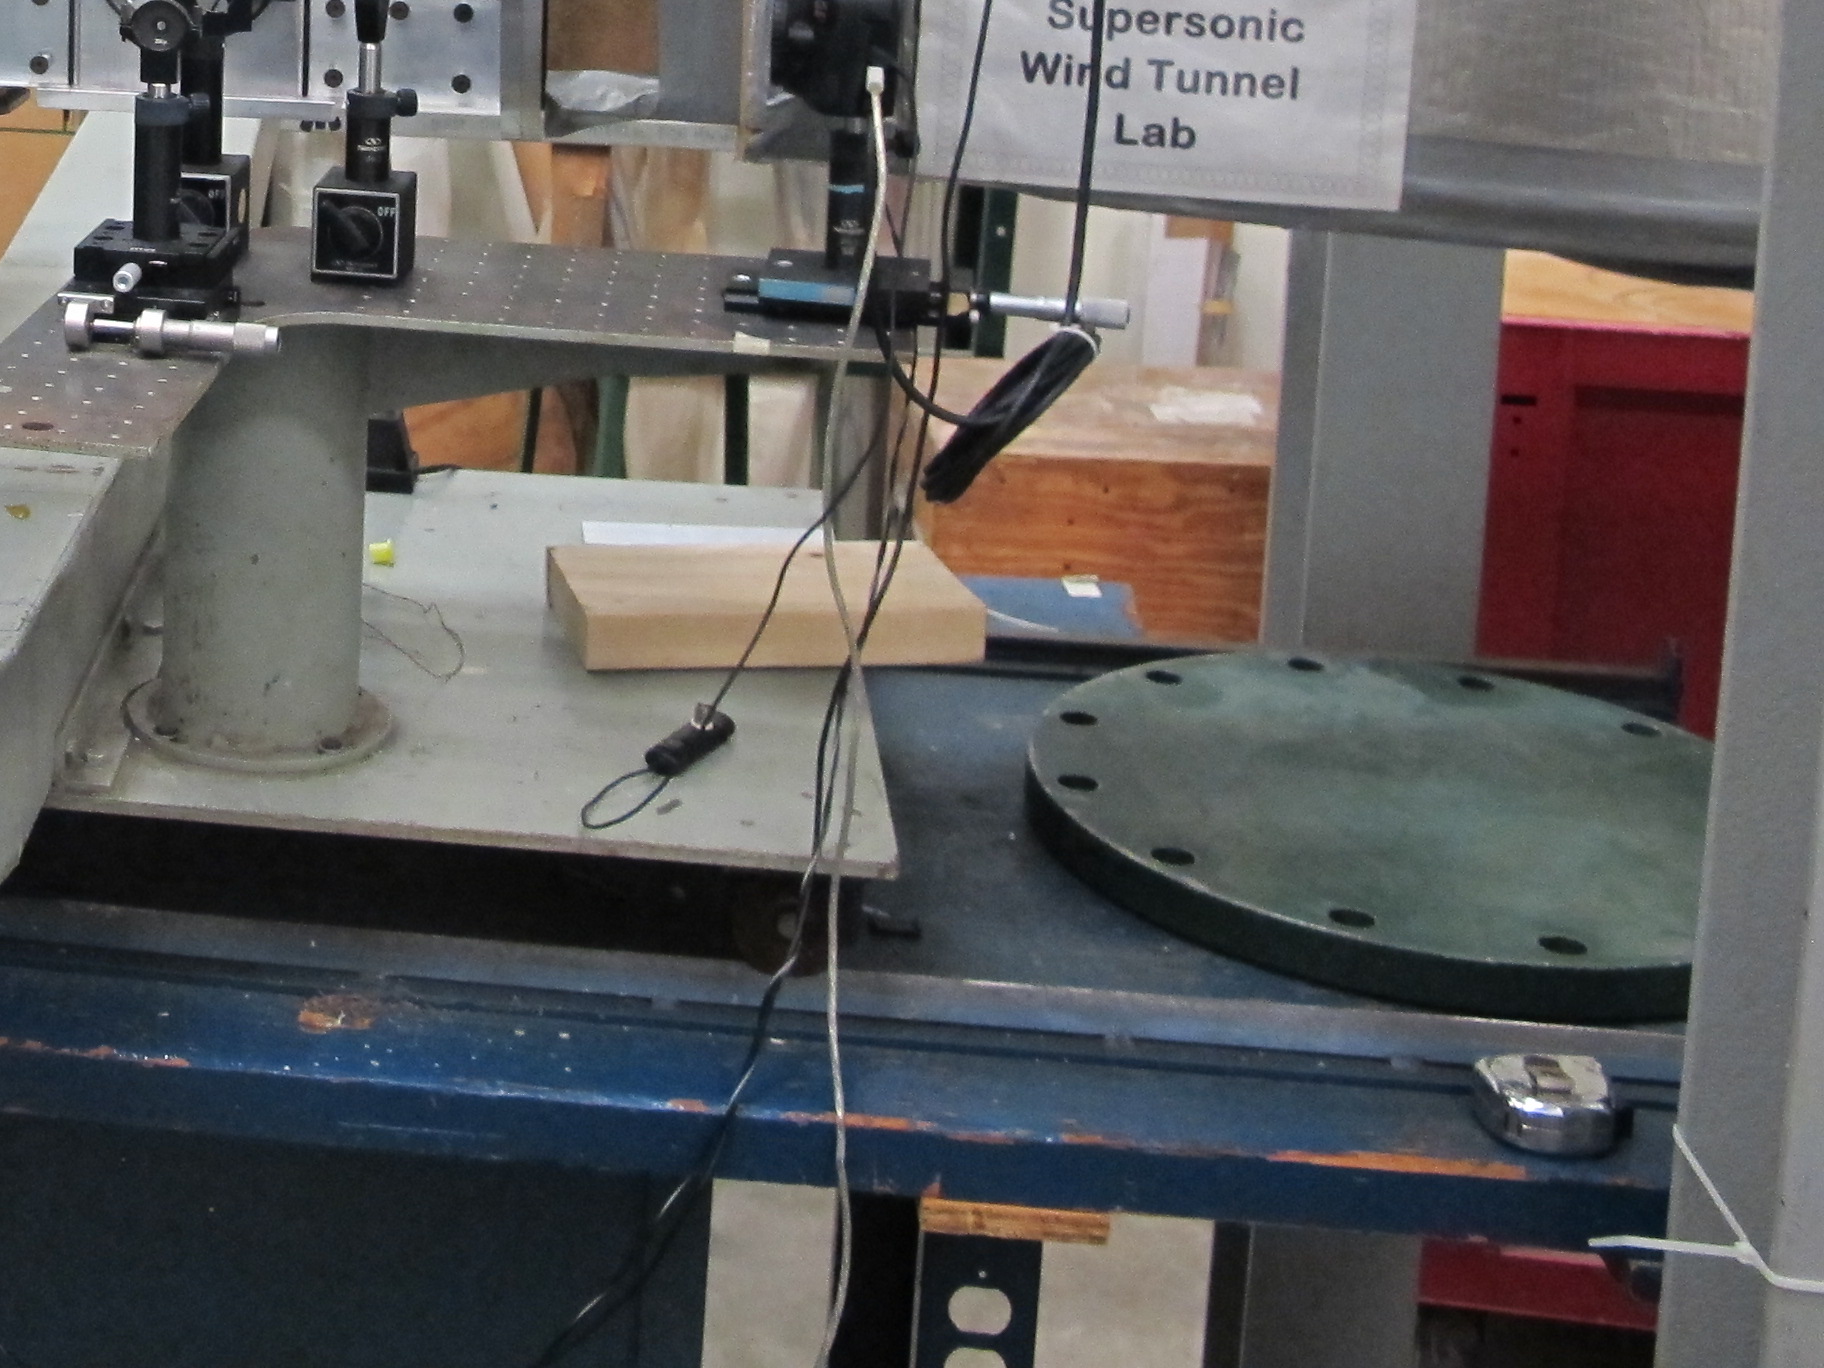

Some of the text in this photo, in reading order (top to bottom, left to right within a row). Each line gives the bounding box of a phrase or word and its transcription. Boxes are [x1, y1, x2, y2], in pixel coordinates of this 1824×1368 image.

[1020, 50, 1299, 100] Wind Tunnel
[1114, 112, 1196, 150] Lab
[377, 206, 396, 217] OFF
